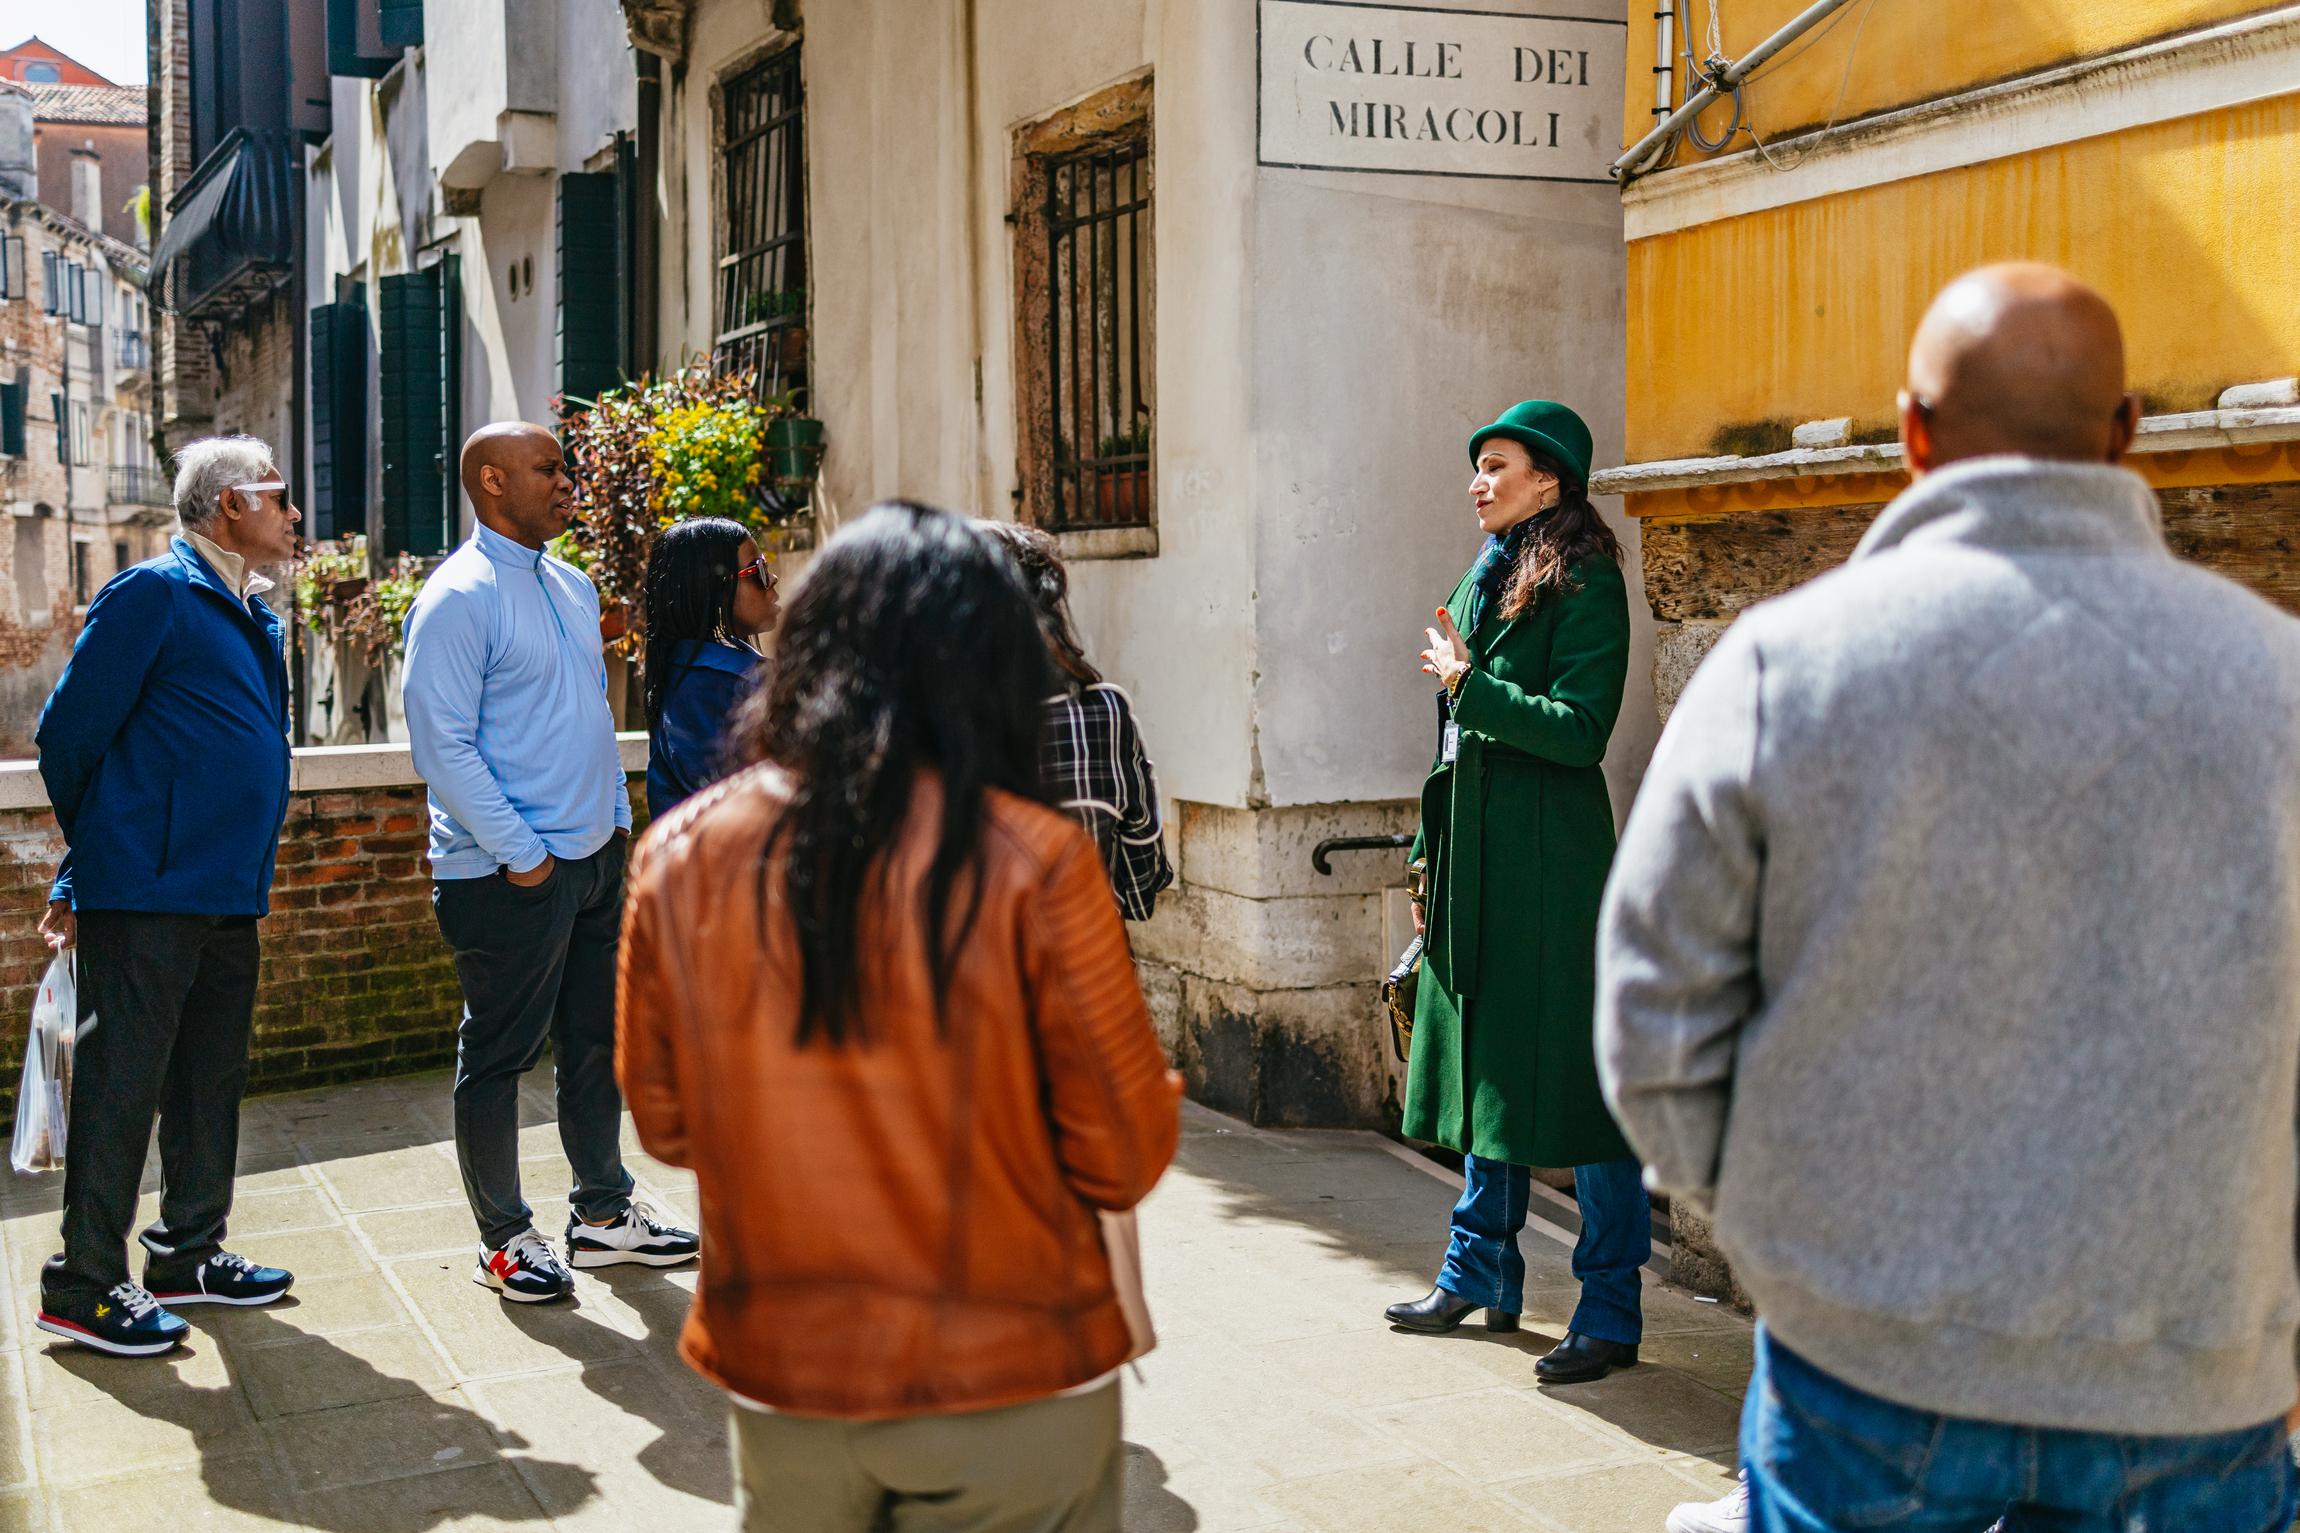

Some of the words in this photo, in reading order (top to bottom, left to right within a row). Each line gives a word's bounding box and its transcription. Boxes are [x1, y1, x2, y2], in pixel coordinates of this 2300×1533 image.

[1303, 35, 1463, 78] CALLE
[1513, 47, 1589, 86] DEI
[1329, 101, 1560, 147] MIRACOLI
